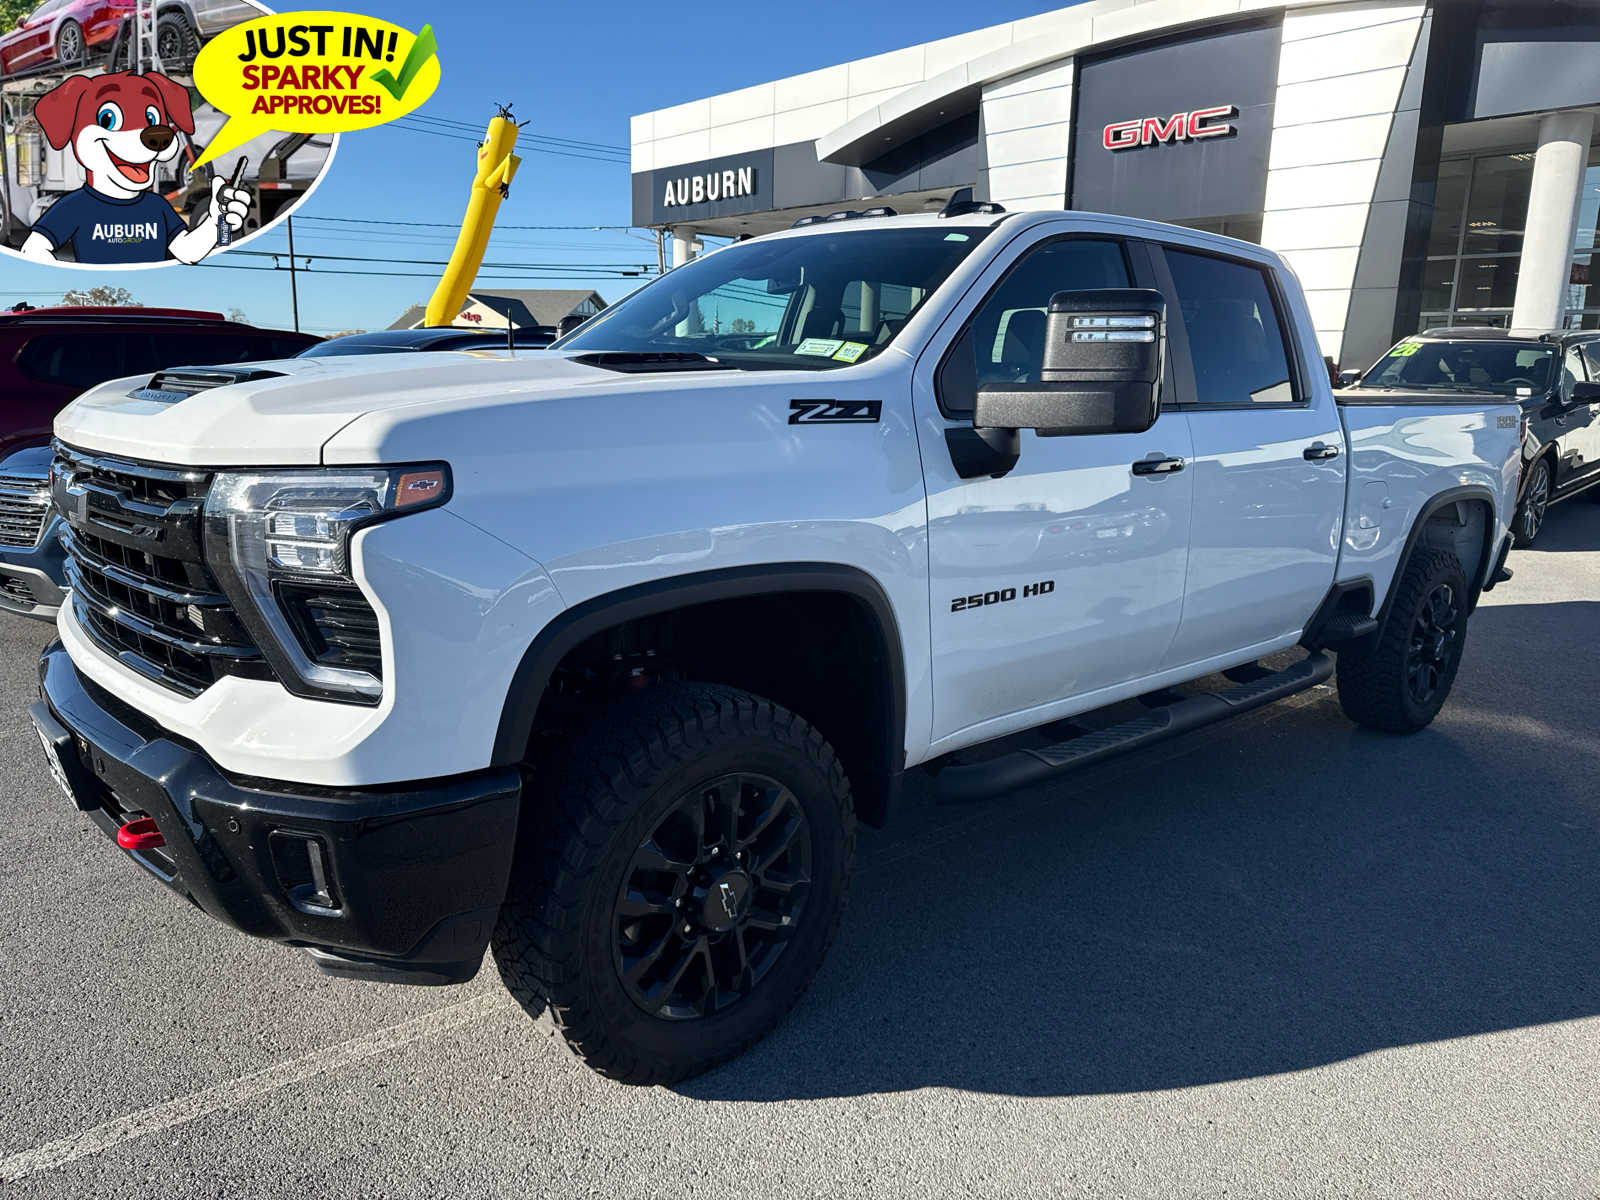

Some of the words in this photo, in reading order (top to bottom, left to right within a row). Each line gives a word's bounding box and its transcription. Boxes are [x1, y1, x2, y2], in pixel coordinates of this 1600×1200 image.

[1103, 104, 1234, 150] GMC
[663, 166, 752, 207] AUBURN
[951, 587, 1017, 613] 2500
[1023, 580, 1055, 598] HD
